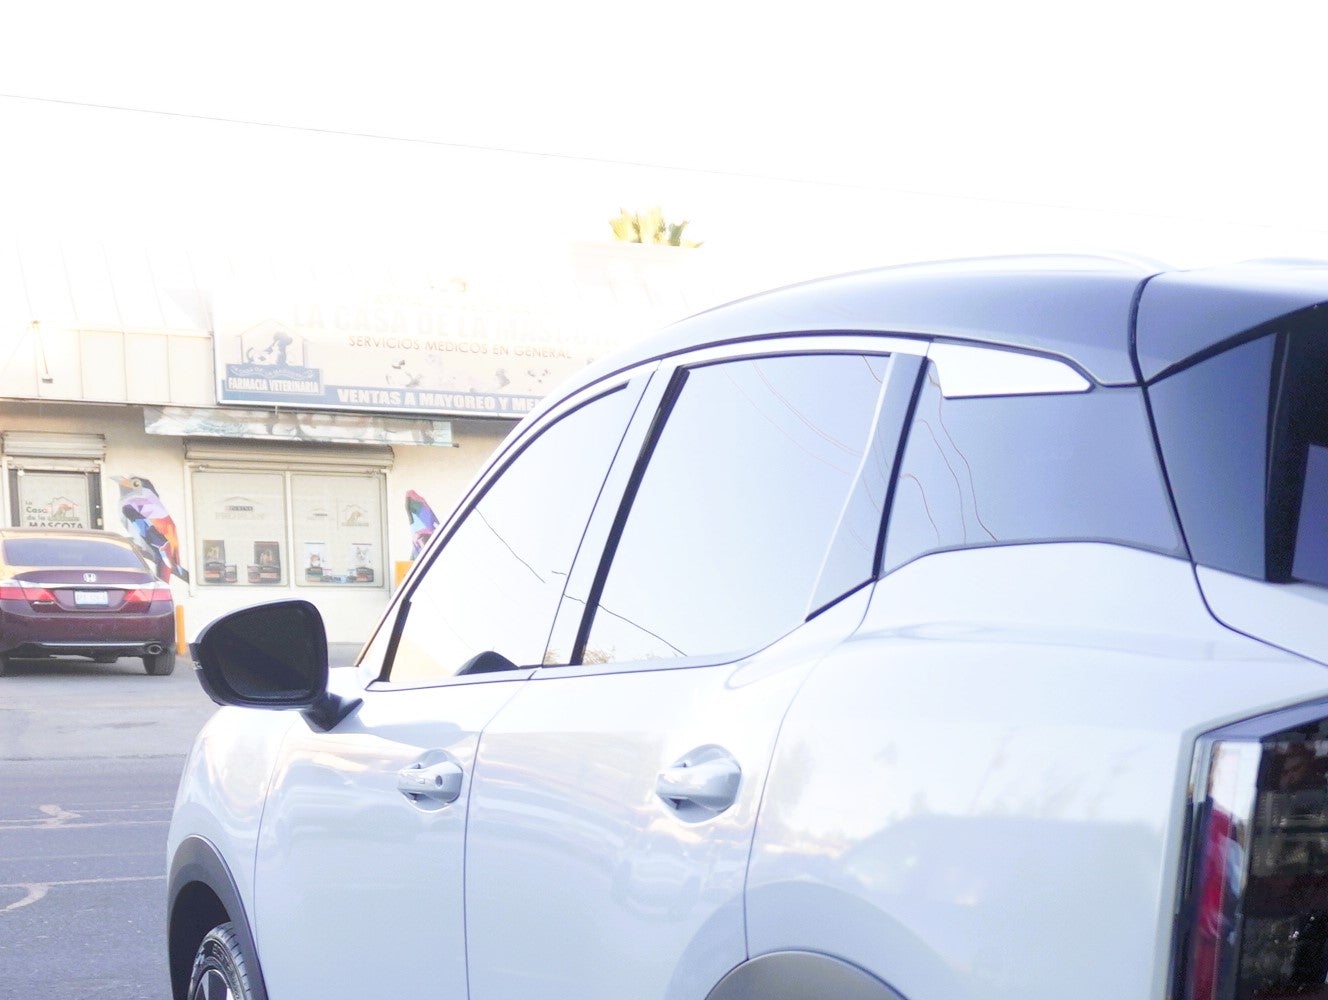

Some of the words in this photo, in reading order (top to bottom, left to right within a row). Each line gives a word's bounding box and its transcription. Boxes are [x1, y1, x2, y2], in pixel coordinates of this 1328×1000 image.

[349, 335, 420, 351] SERVICIOS
[424, 340, 488, 356] MEDICOS
[492, 345, 509, 356] EN
[513, 345, 573, 361] GENERAL
[229, 377, 268, 391] FARMACIA
[269, 379, 319, 394] VETERINARIA
[336, 388, 400, 406] VENTAS
[402, 390, 417, 407] A
[419, 392, 496, 411] MAYOREO
[497, 396, 509, 412] Y
